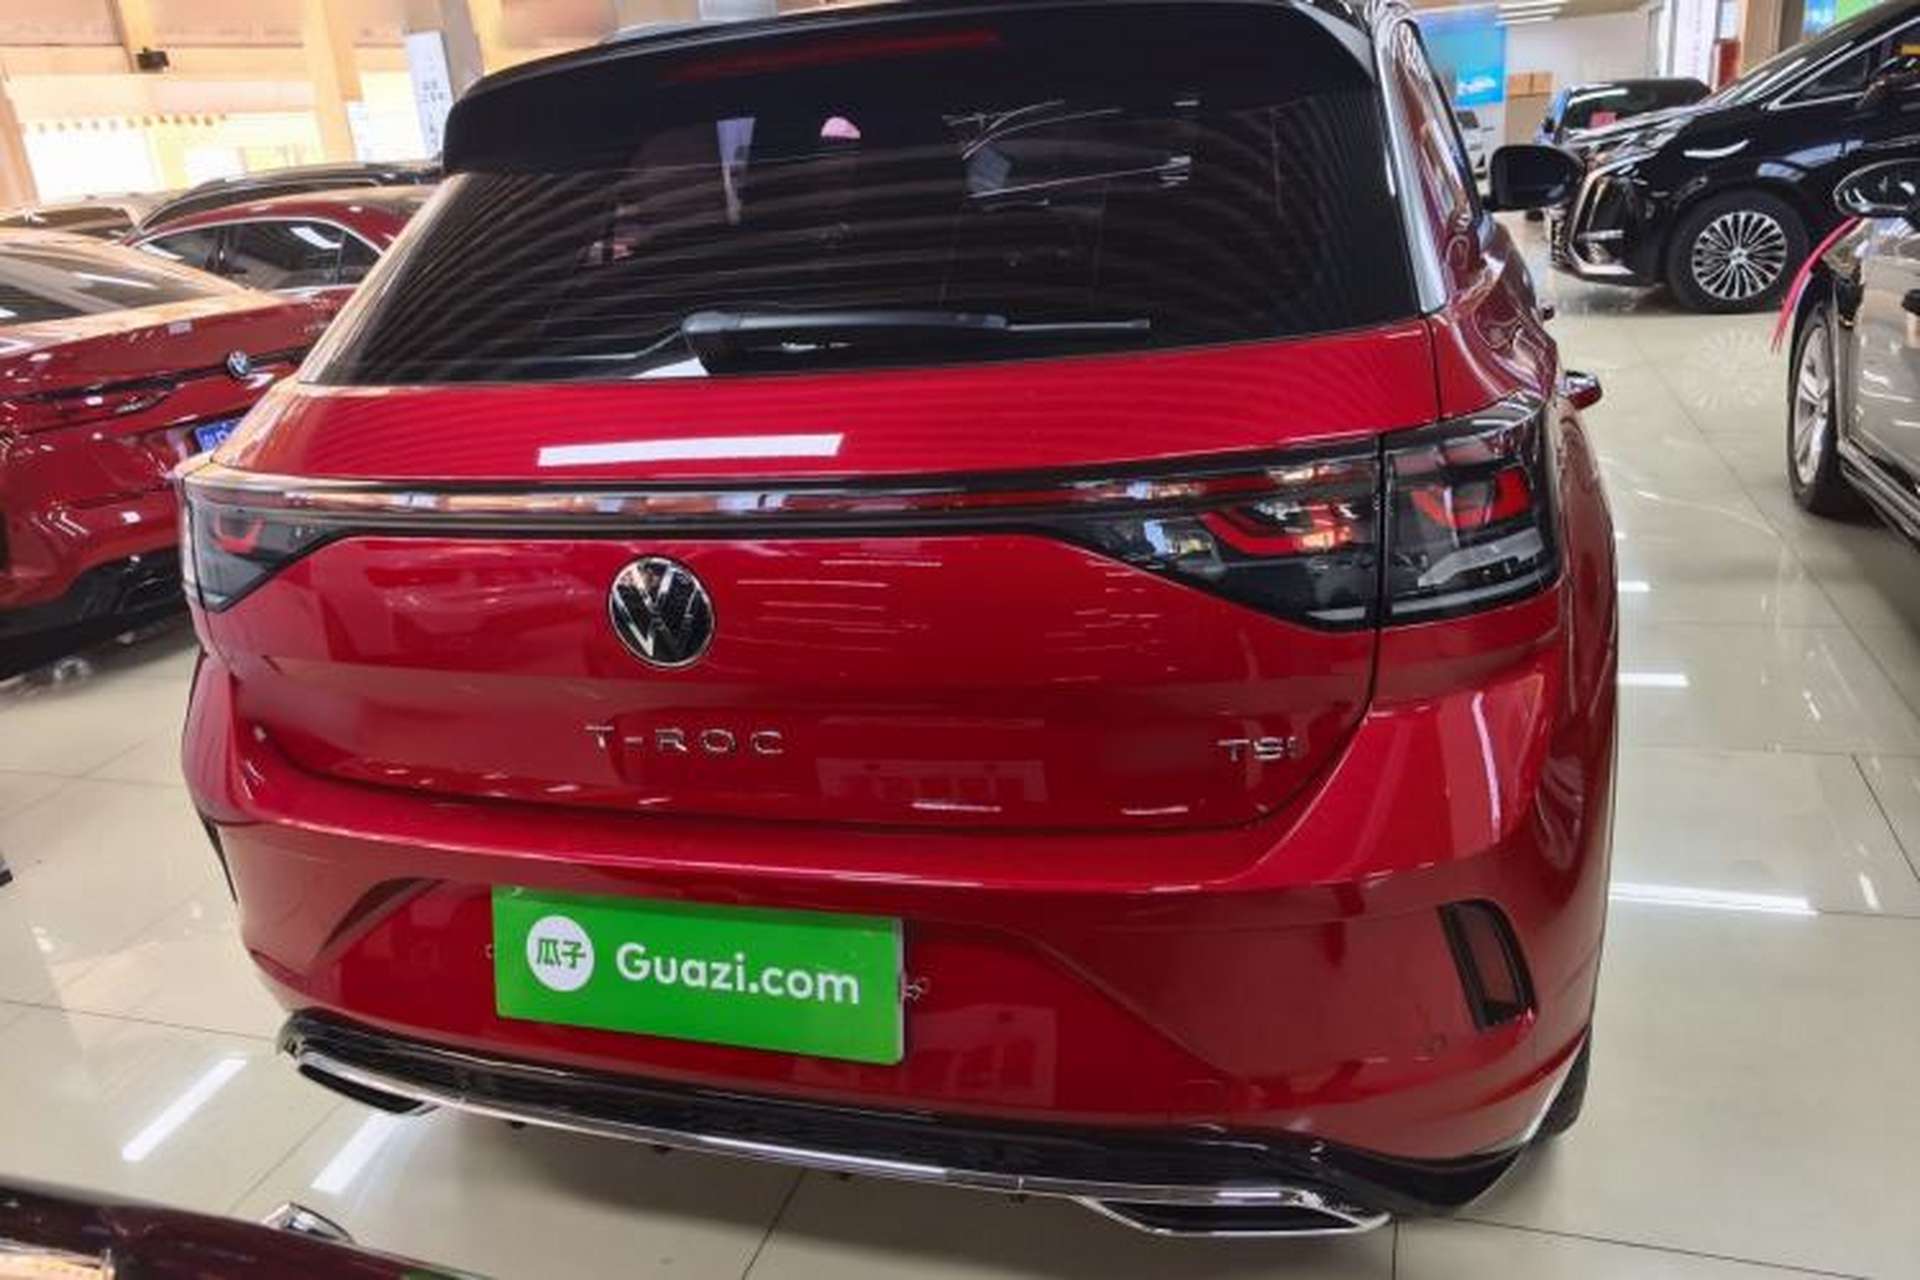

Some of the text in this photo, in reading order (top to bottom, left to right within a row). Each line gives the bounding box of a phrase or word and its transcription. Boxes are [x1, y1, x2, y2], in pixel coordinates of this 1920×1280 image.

[584, 725, 784, 754] T-ROC
[535, 937, 587, 970] 瓜子
[616, 942, 860, 1005] Guazi.com
